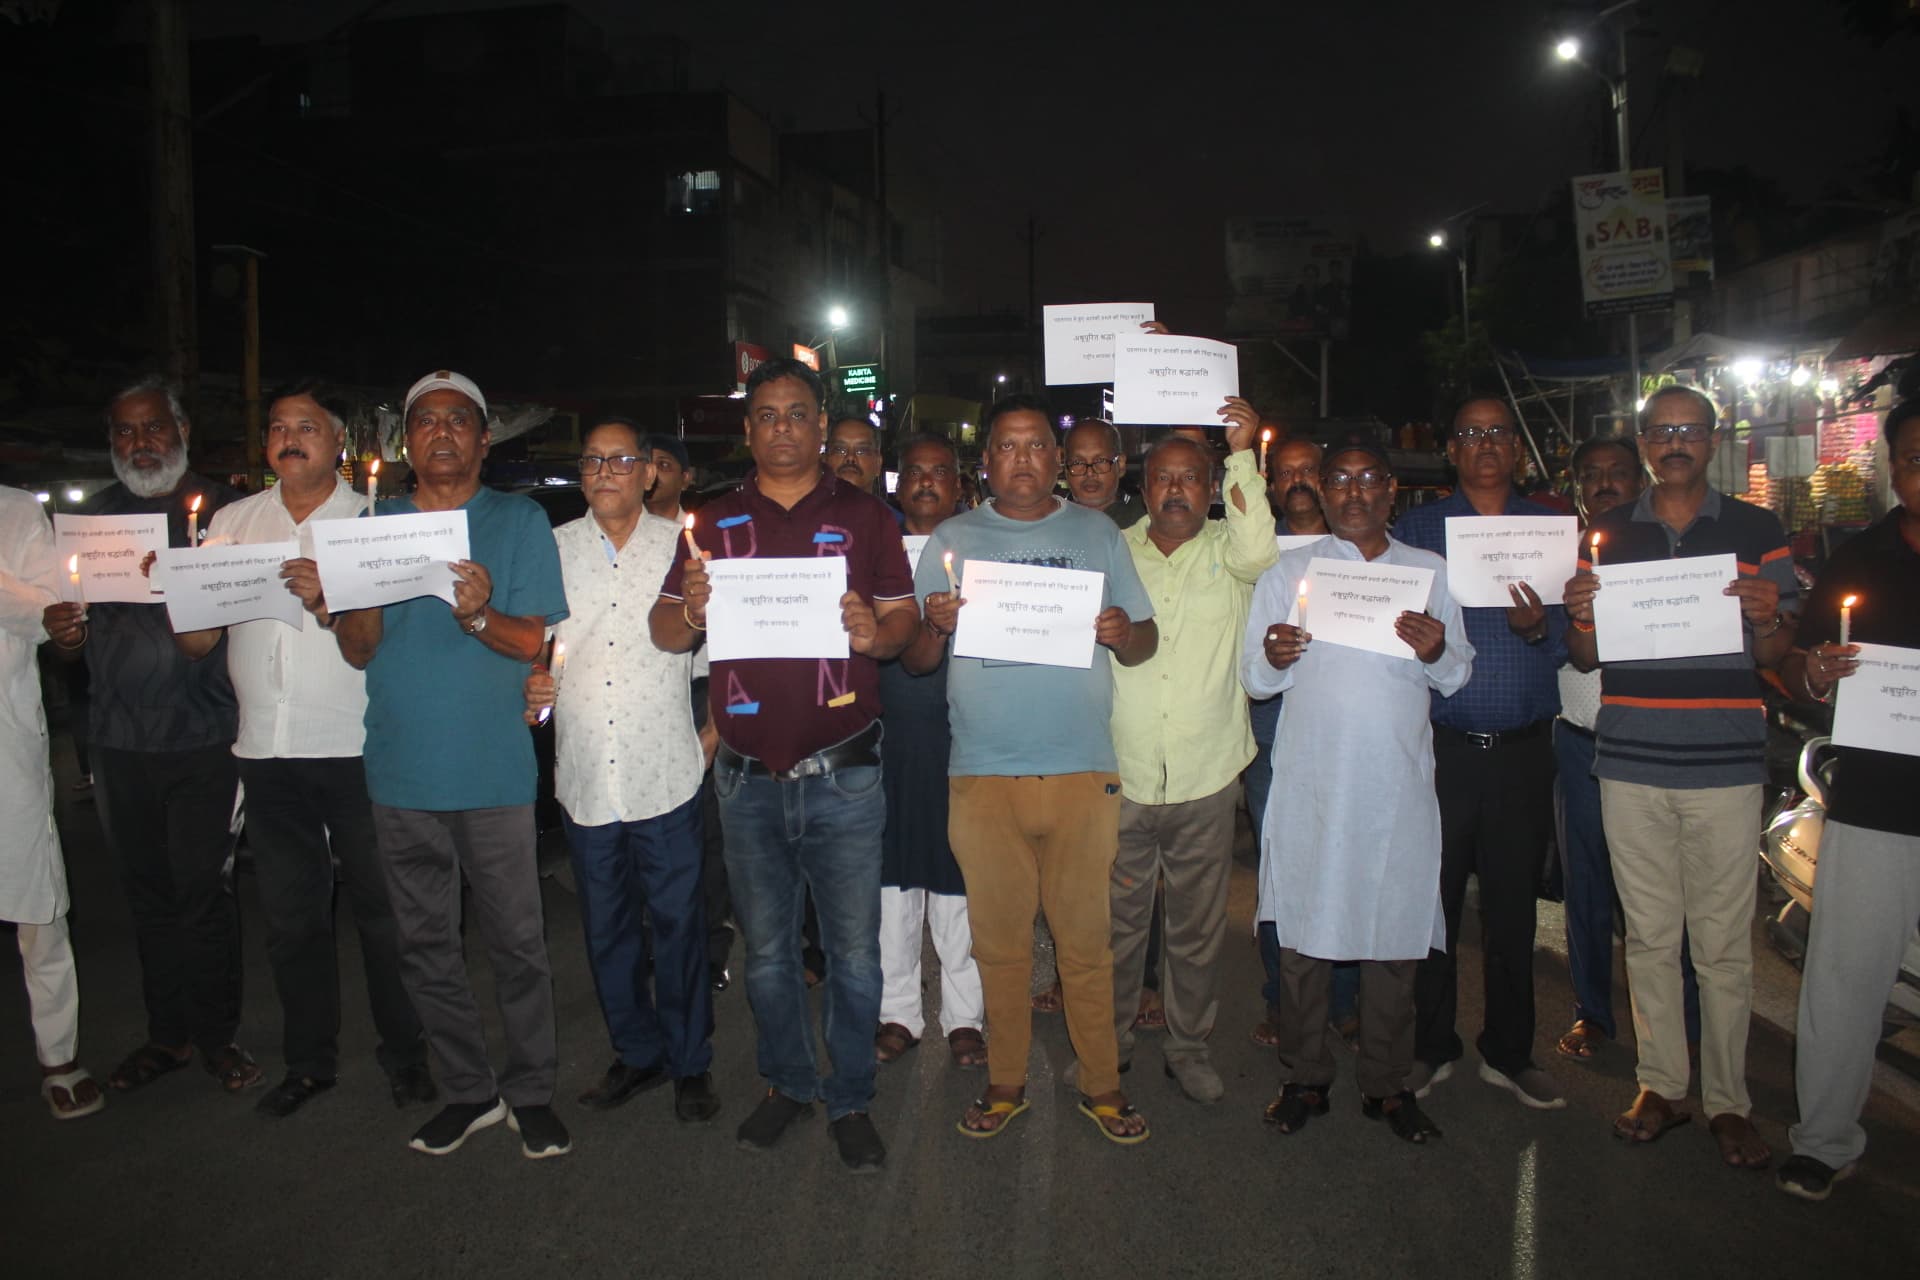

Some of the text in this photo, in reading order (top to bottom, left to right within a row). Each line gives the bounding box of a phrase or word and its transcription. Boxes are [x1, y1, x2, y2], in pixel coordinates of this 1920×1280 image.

[1596, 217, 1651, 242] SAB
[848, 369, 872, 377] KABITA
[844, 376, 876, 385] MEDICINE
